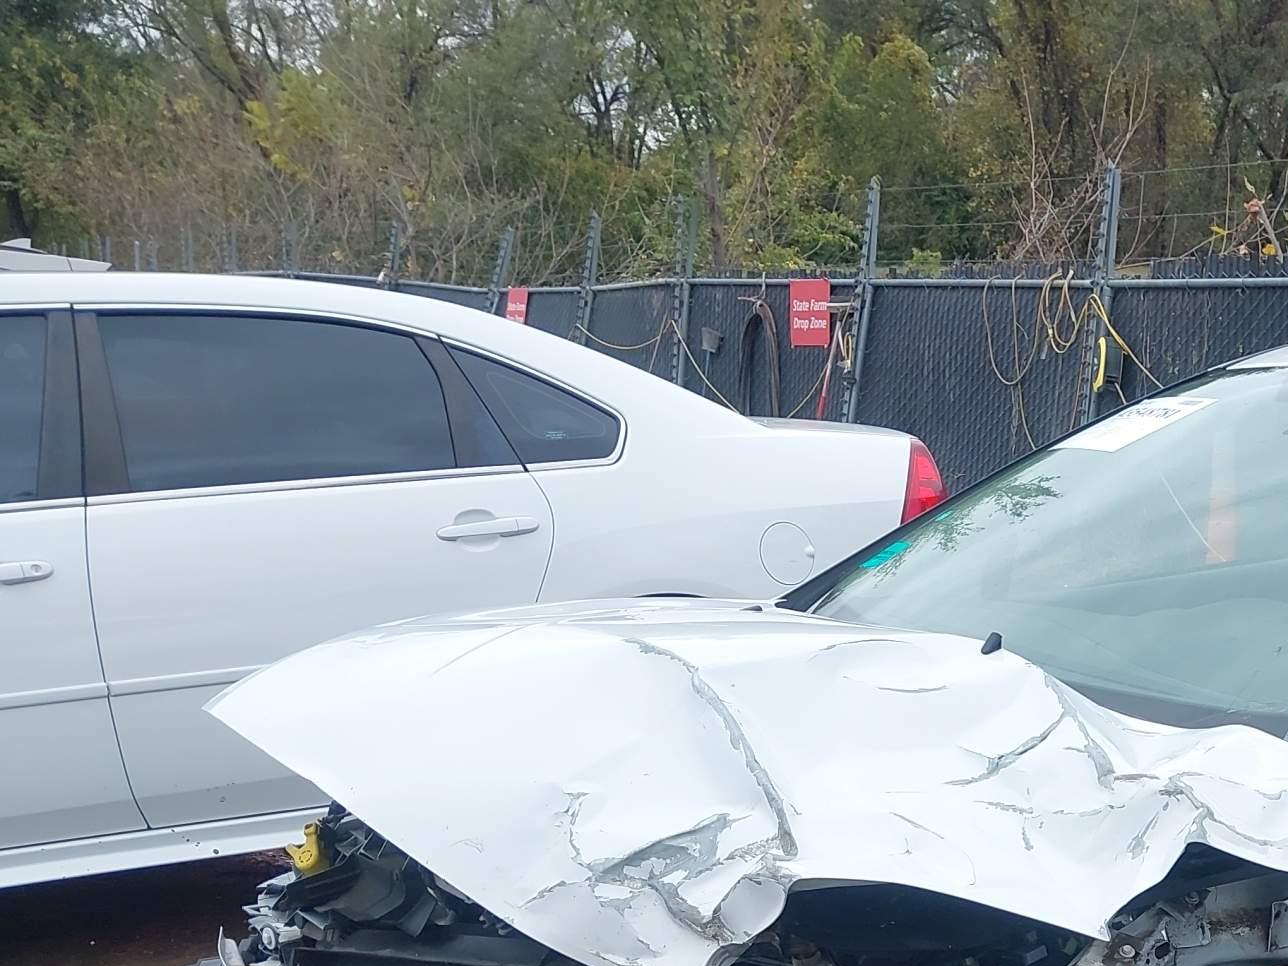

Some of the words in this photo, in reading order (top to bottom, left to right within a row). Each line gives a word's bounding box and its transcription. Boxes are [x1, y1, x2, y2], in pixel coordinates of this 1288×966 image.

[793, 299, 809, 311] State
[810, 299, 827, 311] Farm
[793, 317, 809, 332] Drop
[810, 316, 827, 329] Zone
